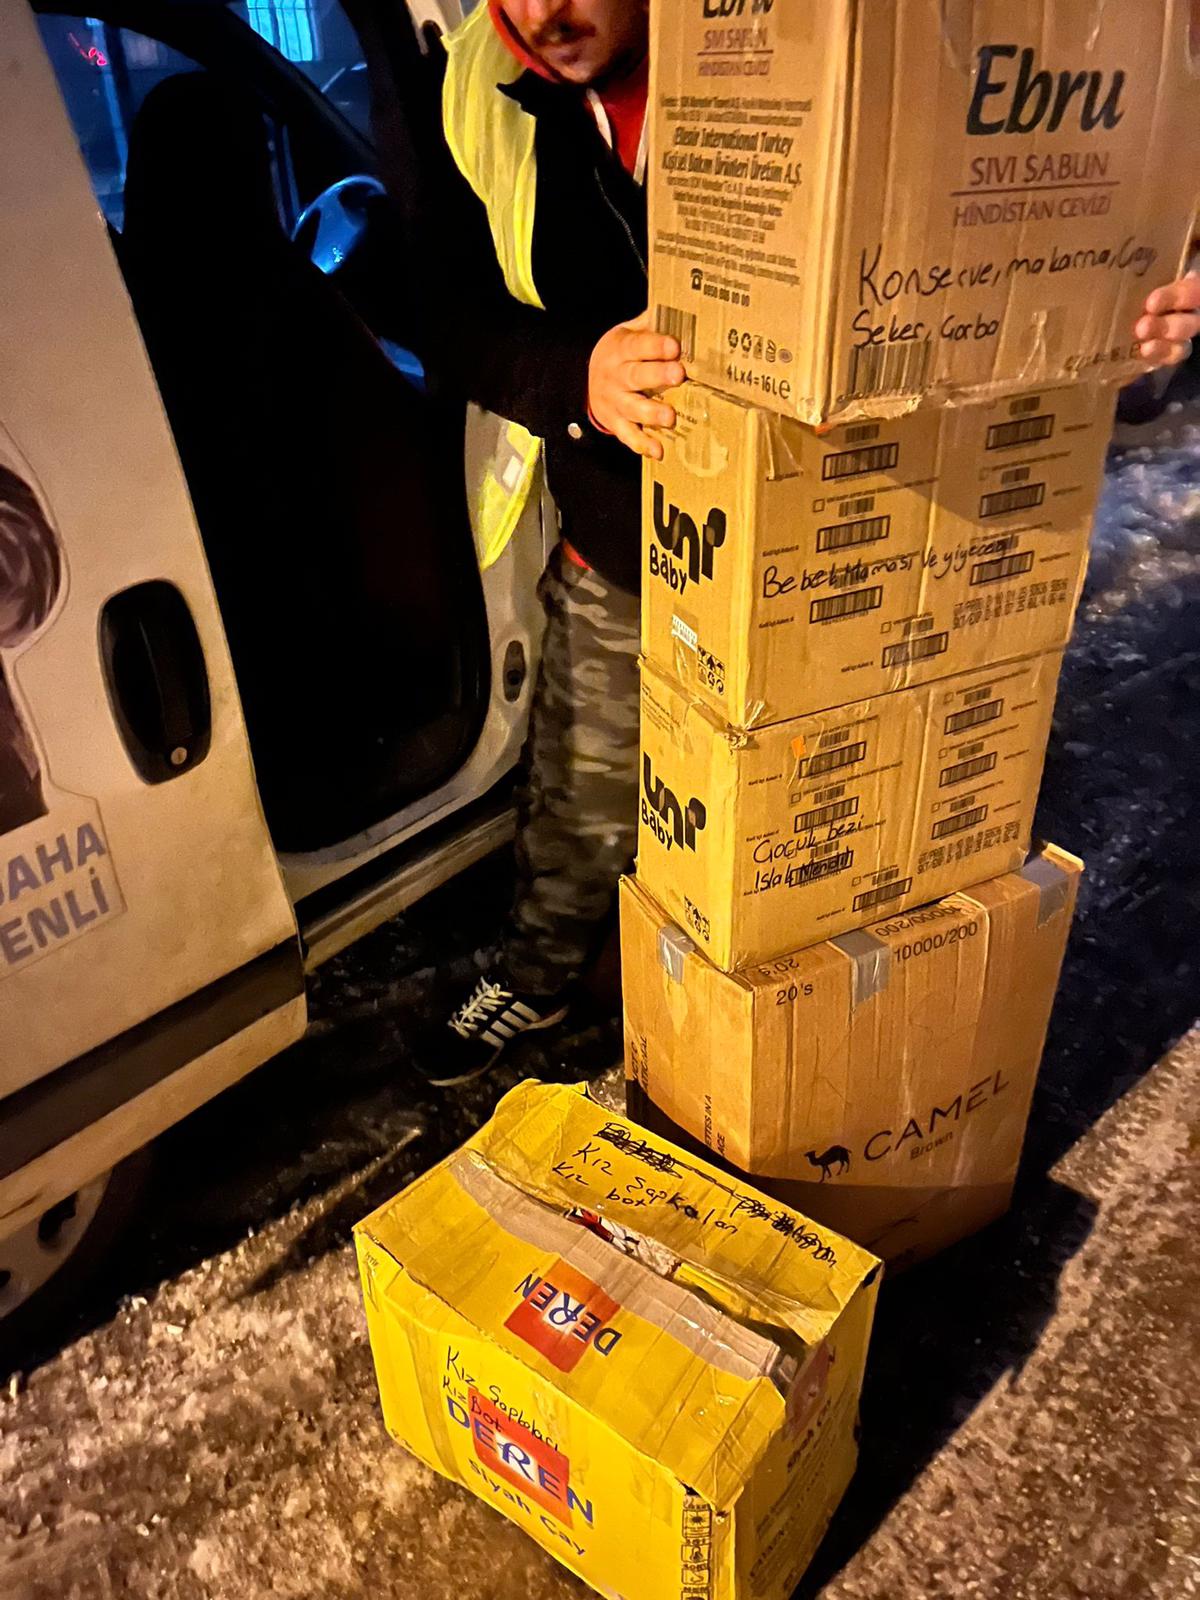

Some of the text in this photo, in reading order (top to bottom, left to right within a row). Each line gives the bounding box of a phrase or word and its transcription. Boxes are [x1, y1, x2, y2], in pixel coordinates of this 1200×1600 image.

[966, 44, 1126, 136] Ebru
[1023, 151, 1110, 183] SABUN
[649, 543, 688, 596] Baby
[640, 797, 675, 851] Baby
[0, 822, 107, 907] AHA
[0, 866, 110, 965] ENLİ
[893, 920, 979, 963] 10000/200
[775, 981, 814, 1006] 20's
[704, 1115, 713, 1147] ETTES
[864, 1070, 1010, 1161] CAMEL
[910, 1131, 953, 1160] Brown
[514, 1273, 623, 1356] DEREN
[447, 1395, 594, 1529] DEREN
